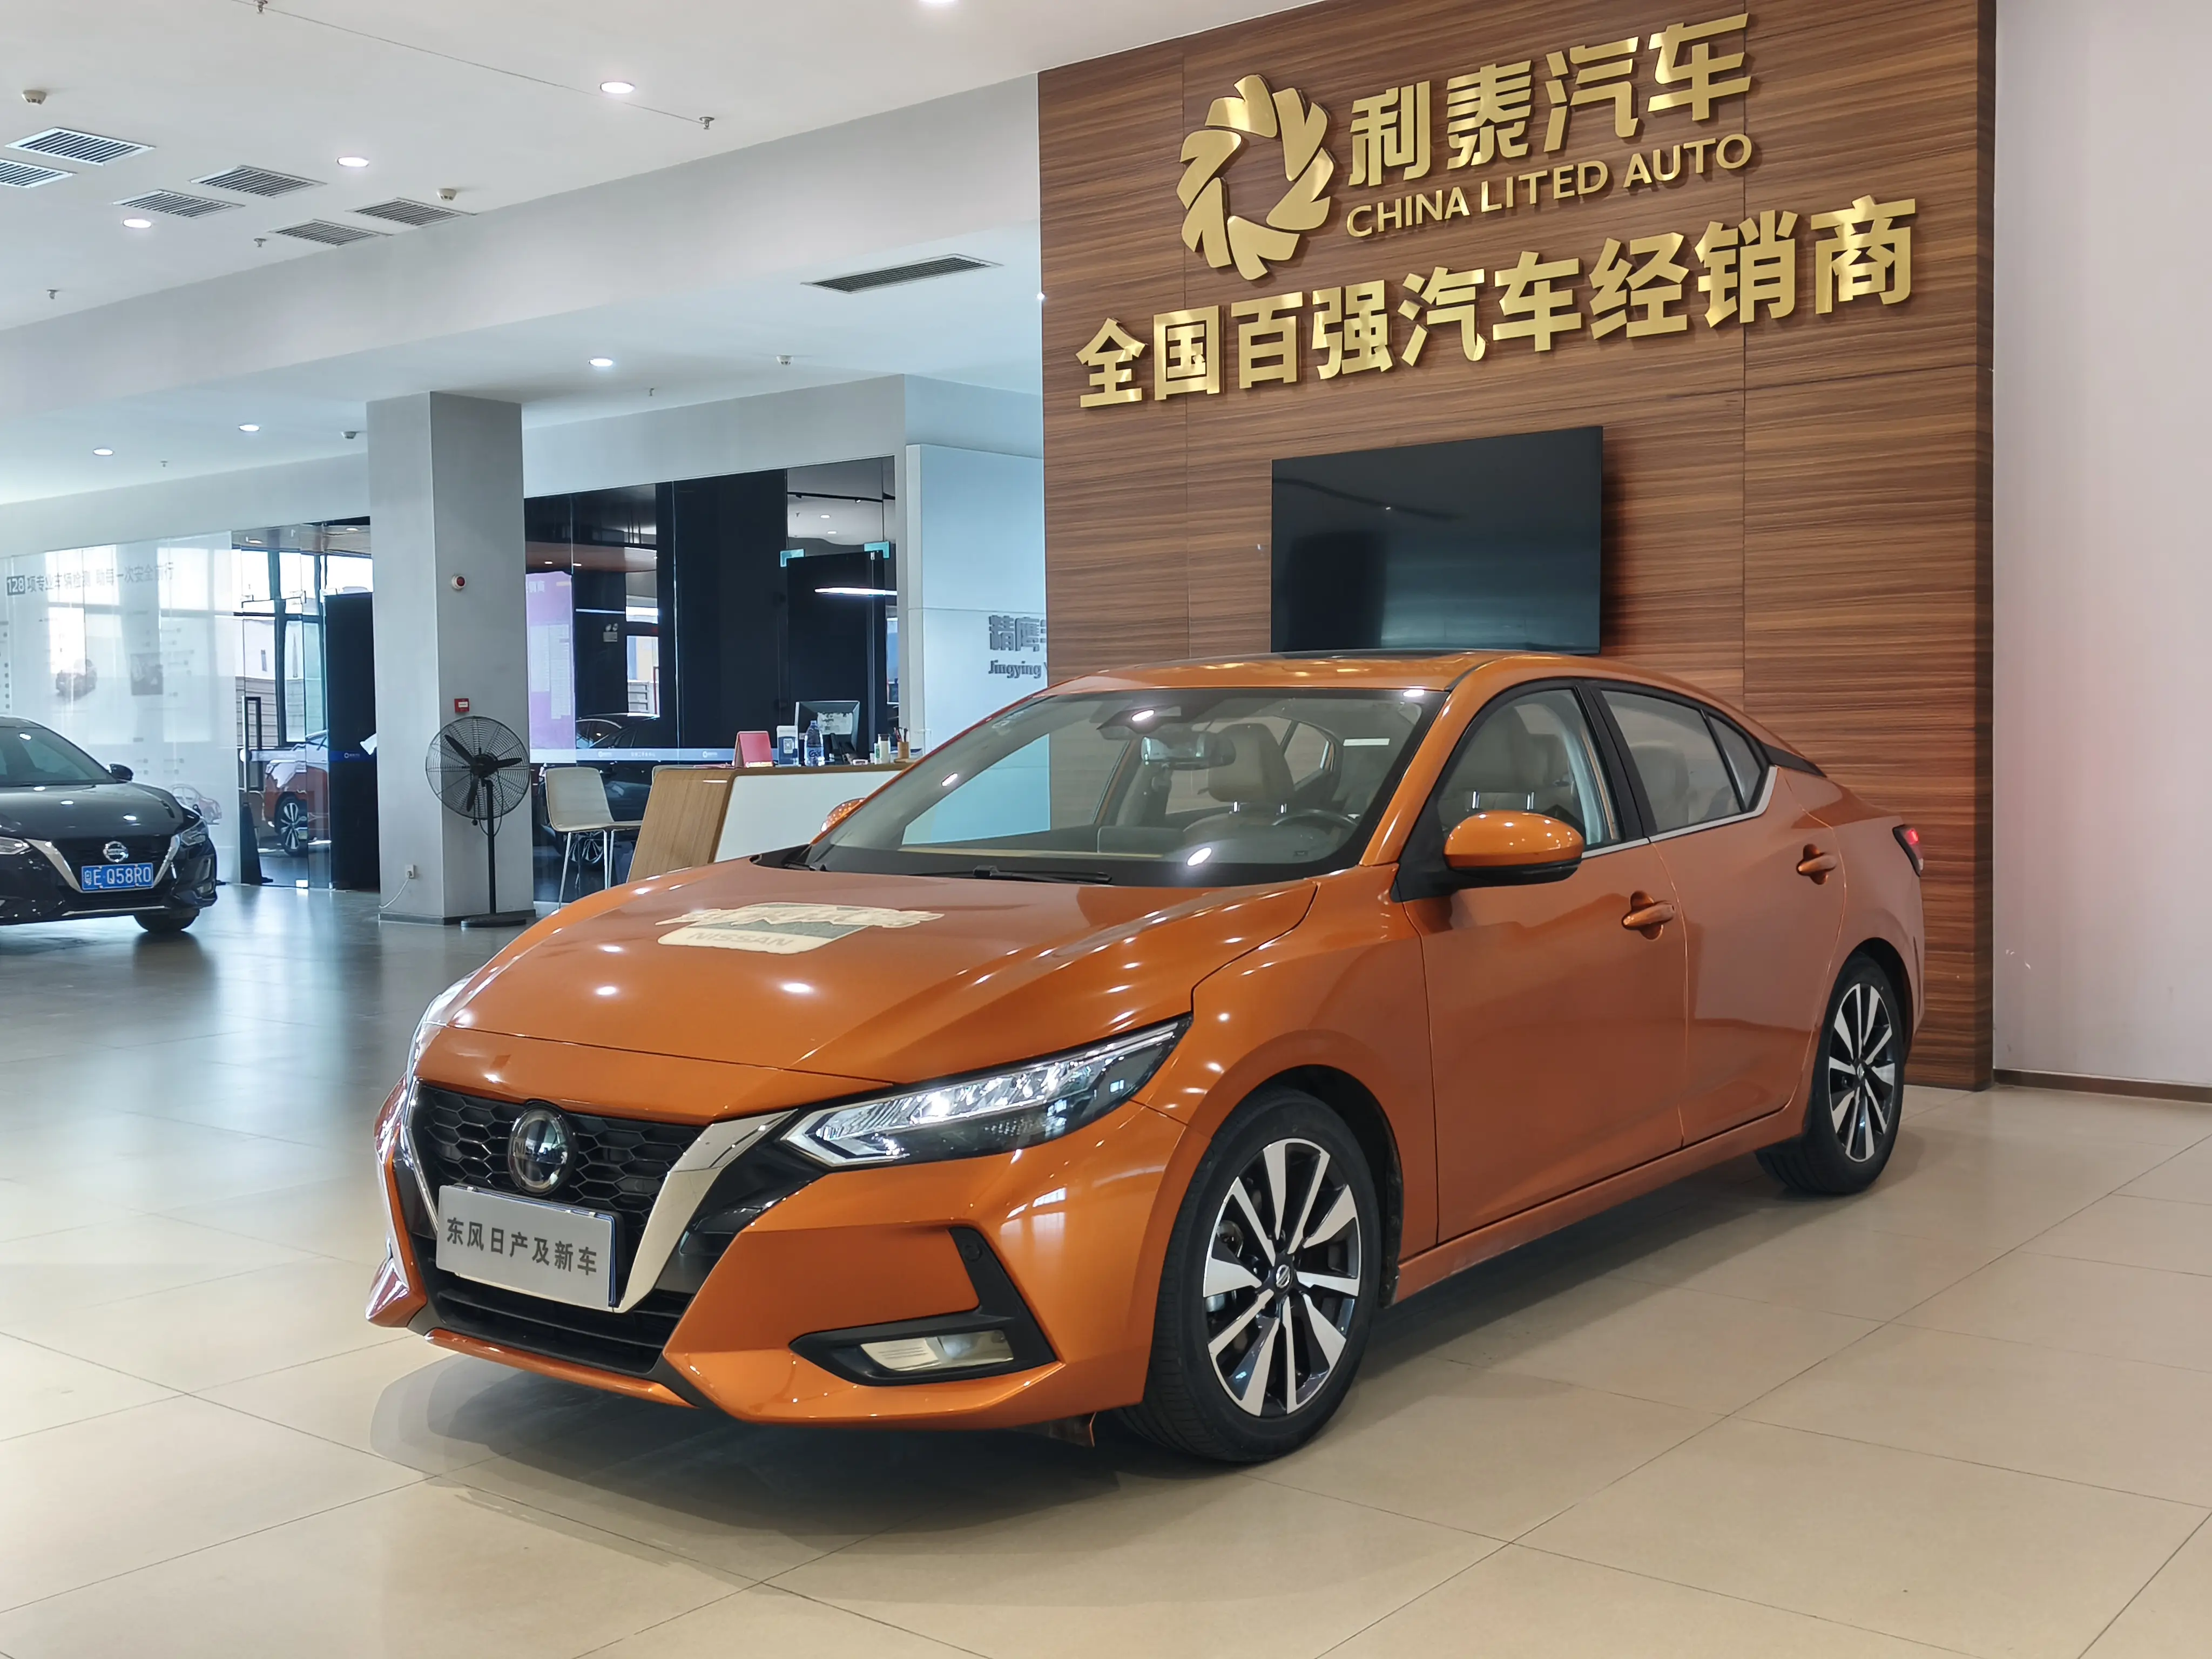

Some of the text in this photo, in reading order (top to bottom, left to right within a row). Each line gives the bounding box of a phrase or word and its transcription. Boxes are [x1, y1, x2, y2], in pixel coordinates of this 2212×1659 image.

[1347, 12, 1751, 187] 利泰汽车
[1347, 133, 1752, 237] CHINA LITED AUTO
[1076, 194, 1917, 408] 全国百强汽车经销商
[988, 615, 1046, 652] 精鹰
[988, 659, 1042, 679] Jingying
[687, 932, 794, 946] NISSAN
[447, 1217, 597, 1276] 东风日产及新车
